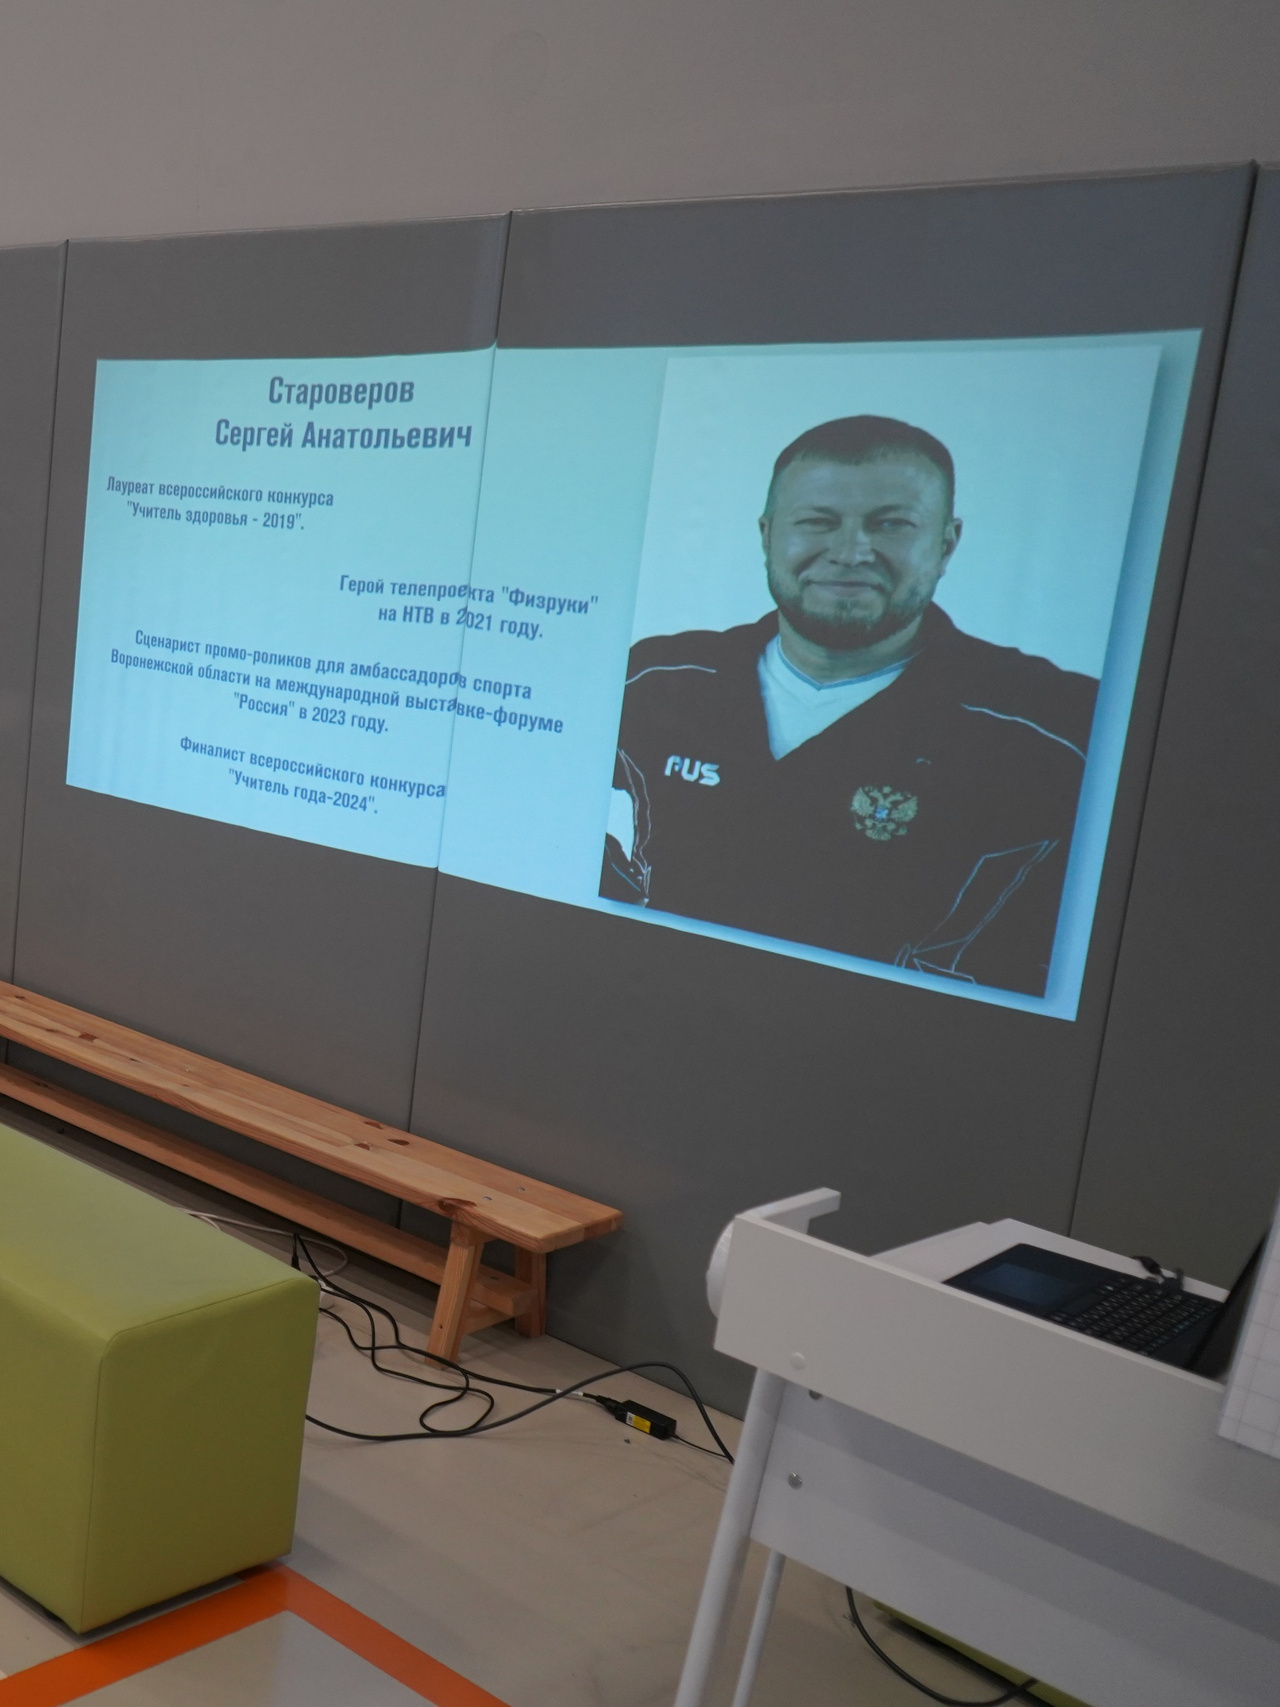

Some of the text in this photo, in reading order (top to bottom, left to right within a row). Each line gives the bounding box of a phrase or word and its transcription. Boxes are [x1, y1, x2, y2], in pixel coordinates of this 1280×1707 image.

[269, 377, 415, 409] Староверов
[215, 419, 473, 451] Сергей Анатольевич
[107, 476, 334, 508] Лауреат всероссийского конкурса
[127, 501, 181, 522] "Учитель
[185, 505, 248, 527] здоровья
[263, 512, 304, 530] 2019".
[340, 575, 598, 615] Герой телепроекта "Физруки"
[379, 606, 543, 641] на НТВ в 2021 году.
[135, 630, 532, 702] Сценарист промо-роликов для амбассадоров спорта
[111, 648, 563, 735] Воронежской области на международной выставке-форуме
[234, 691, 389, 736] "Россия" в 2023 году.
[180, 736, 446, 798] Финалист всероссийского конкурса
[229, 768, 378, 814] "Учитель года-2024".
